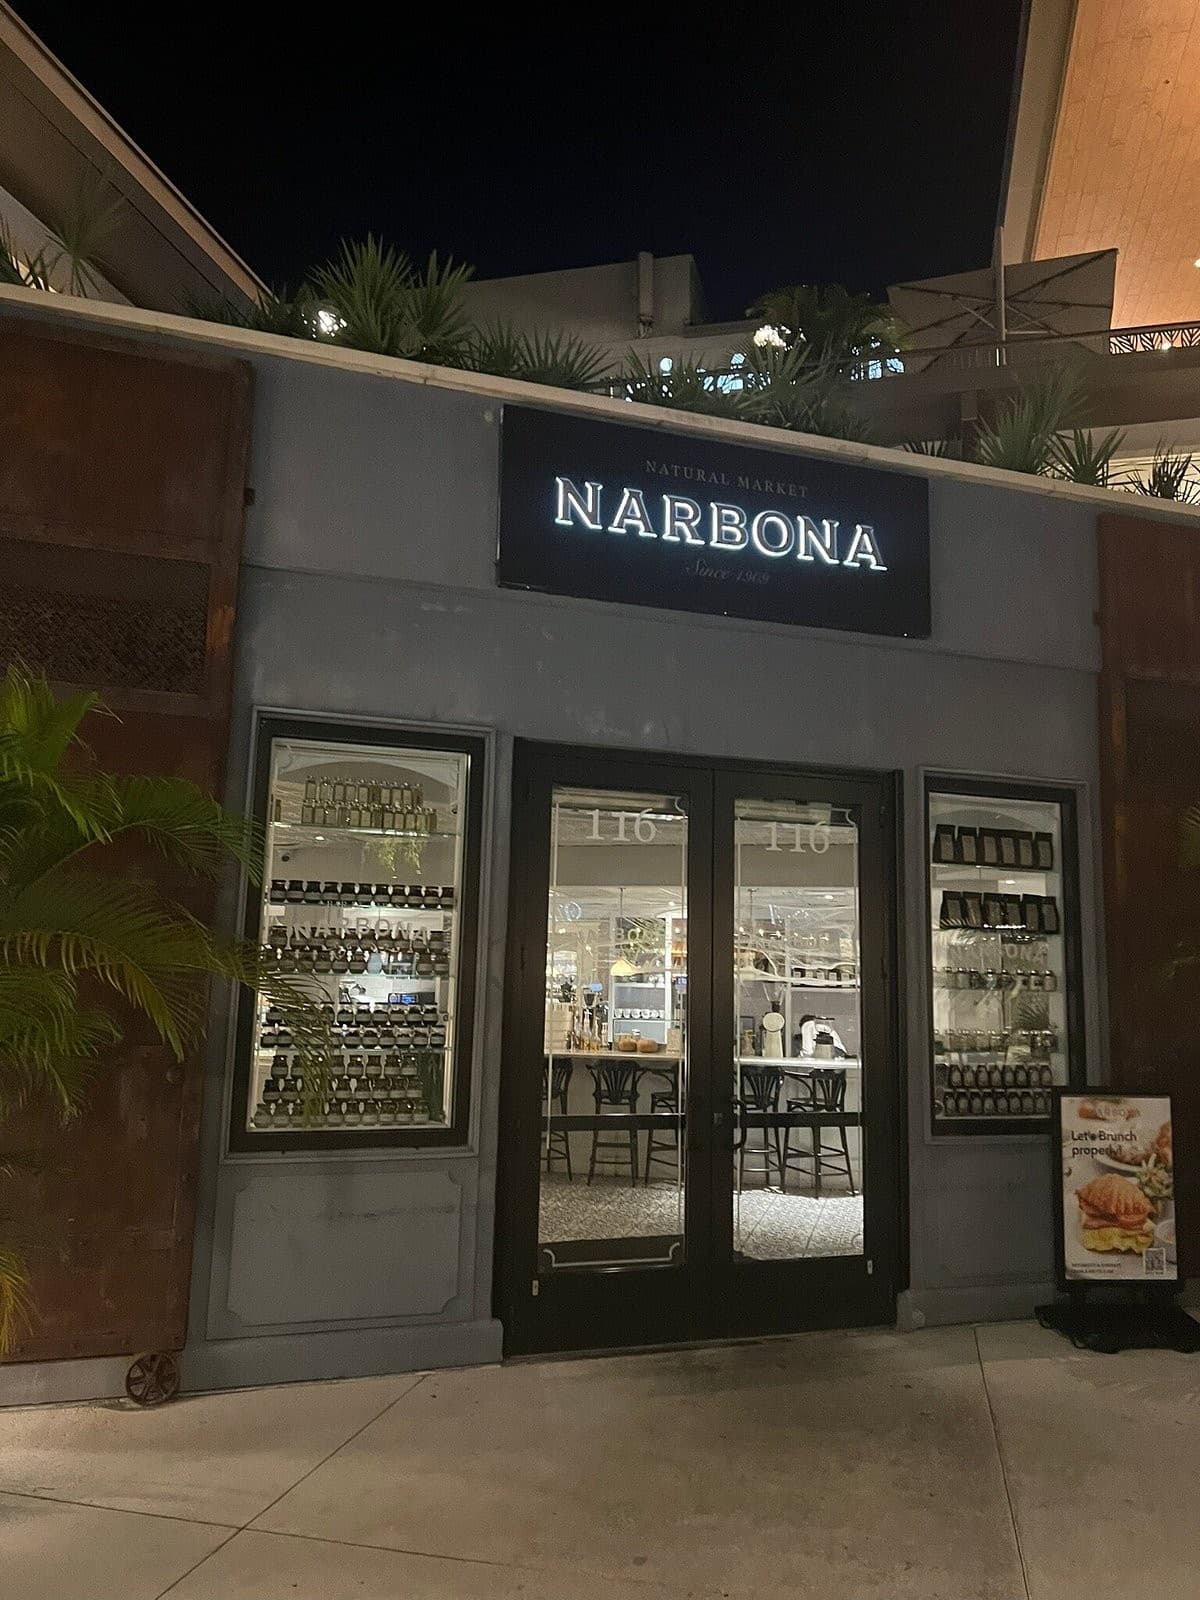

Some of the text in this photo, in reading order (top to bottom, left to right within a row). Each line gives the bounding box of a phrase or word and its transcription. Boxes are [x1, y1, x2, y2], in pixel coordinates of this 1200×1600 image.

[645, 459, 809, 499] NATURAL MARKET
[553, 475, 889, 572] NARBONA
[681, 558, 730, 581] Since
[585, 807, 657, 843] 116
[765, 820, 831, 854] 116
[1098, 1130, 1137, 1141] Brunch
